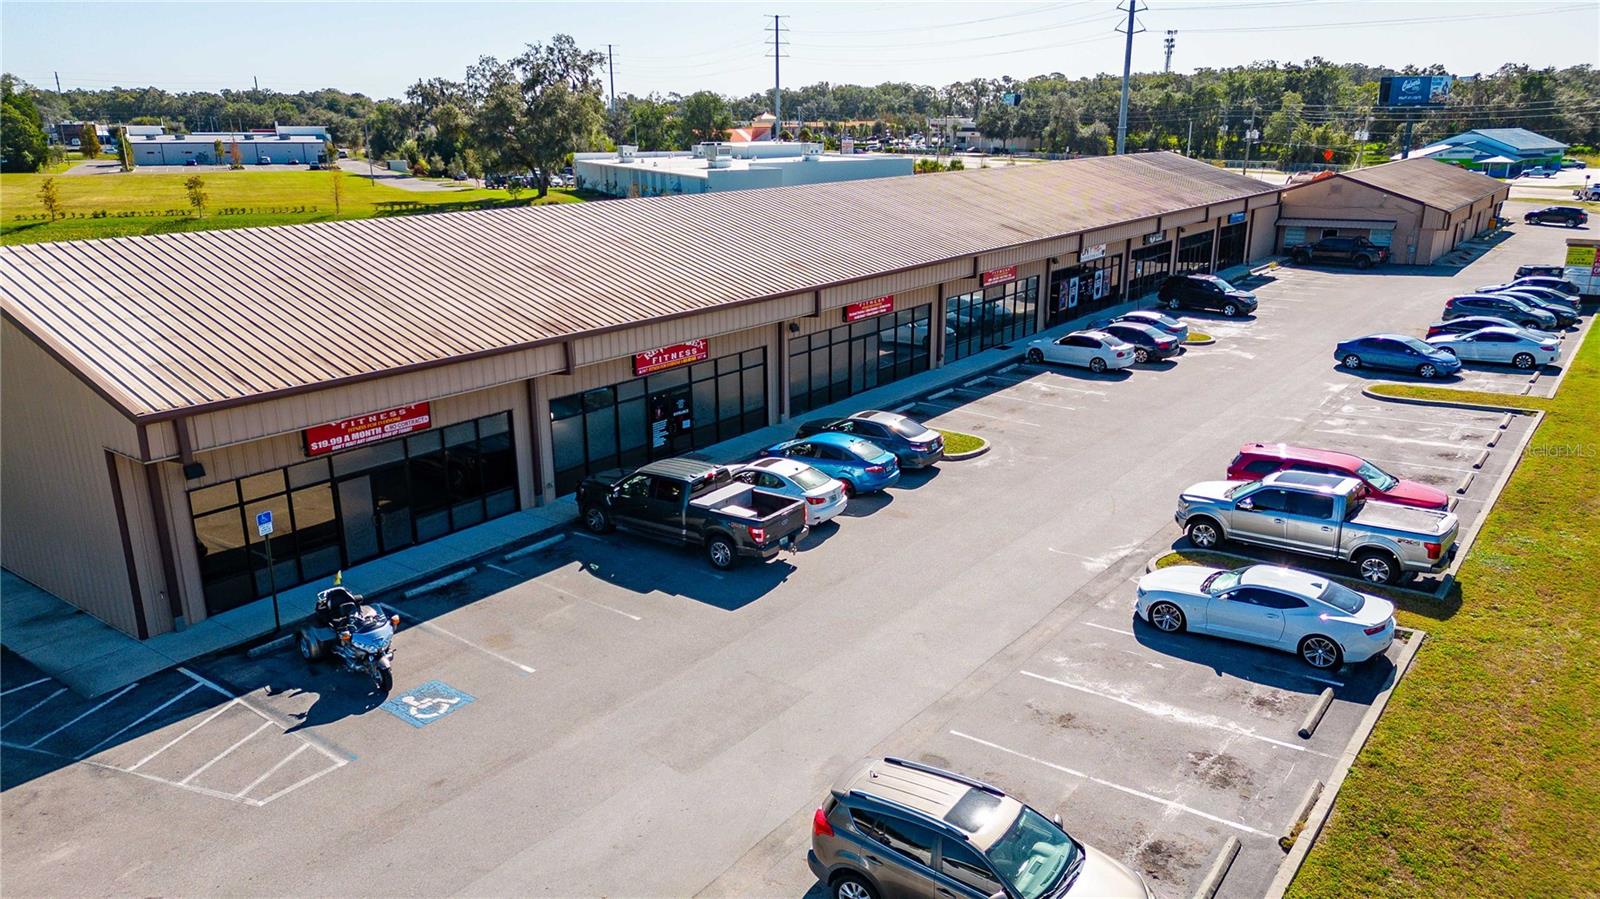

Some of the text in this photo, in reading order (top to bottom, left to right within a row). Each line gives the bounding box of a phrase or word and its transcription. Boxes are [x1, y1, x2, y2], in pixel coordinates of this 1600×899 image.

[652, 348, 697, 364] FITNESS
[341, 408, 406, 429] FITNESS
[311, 436, 342, 450] $19.99
[344, 434, 351, 443] A
[352, 427, 382, 440] MONTH
